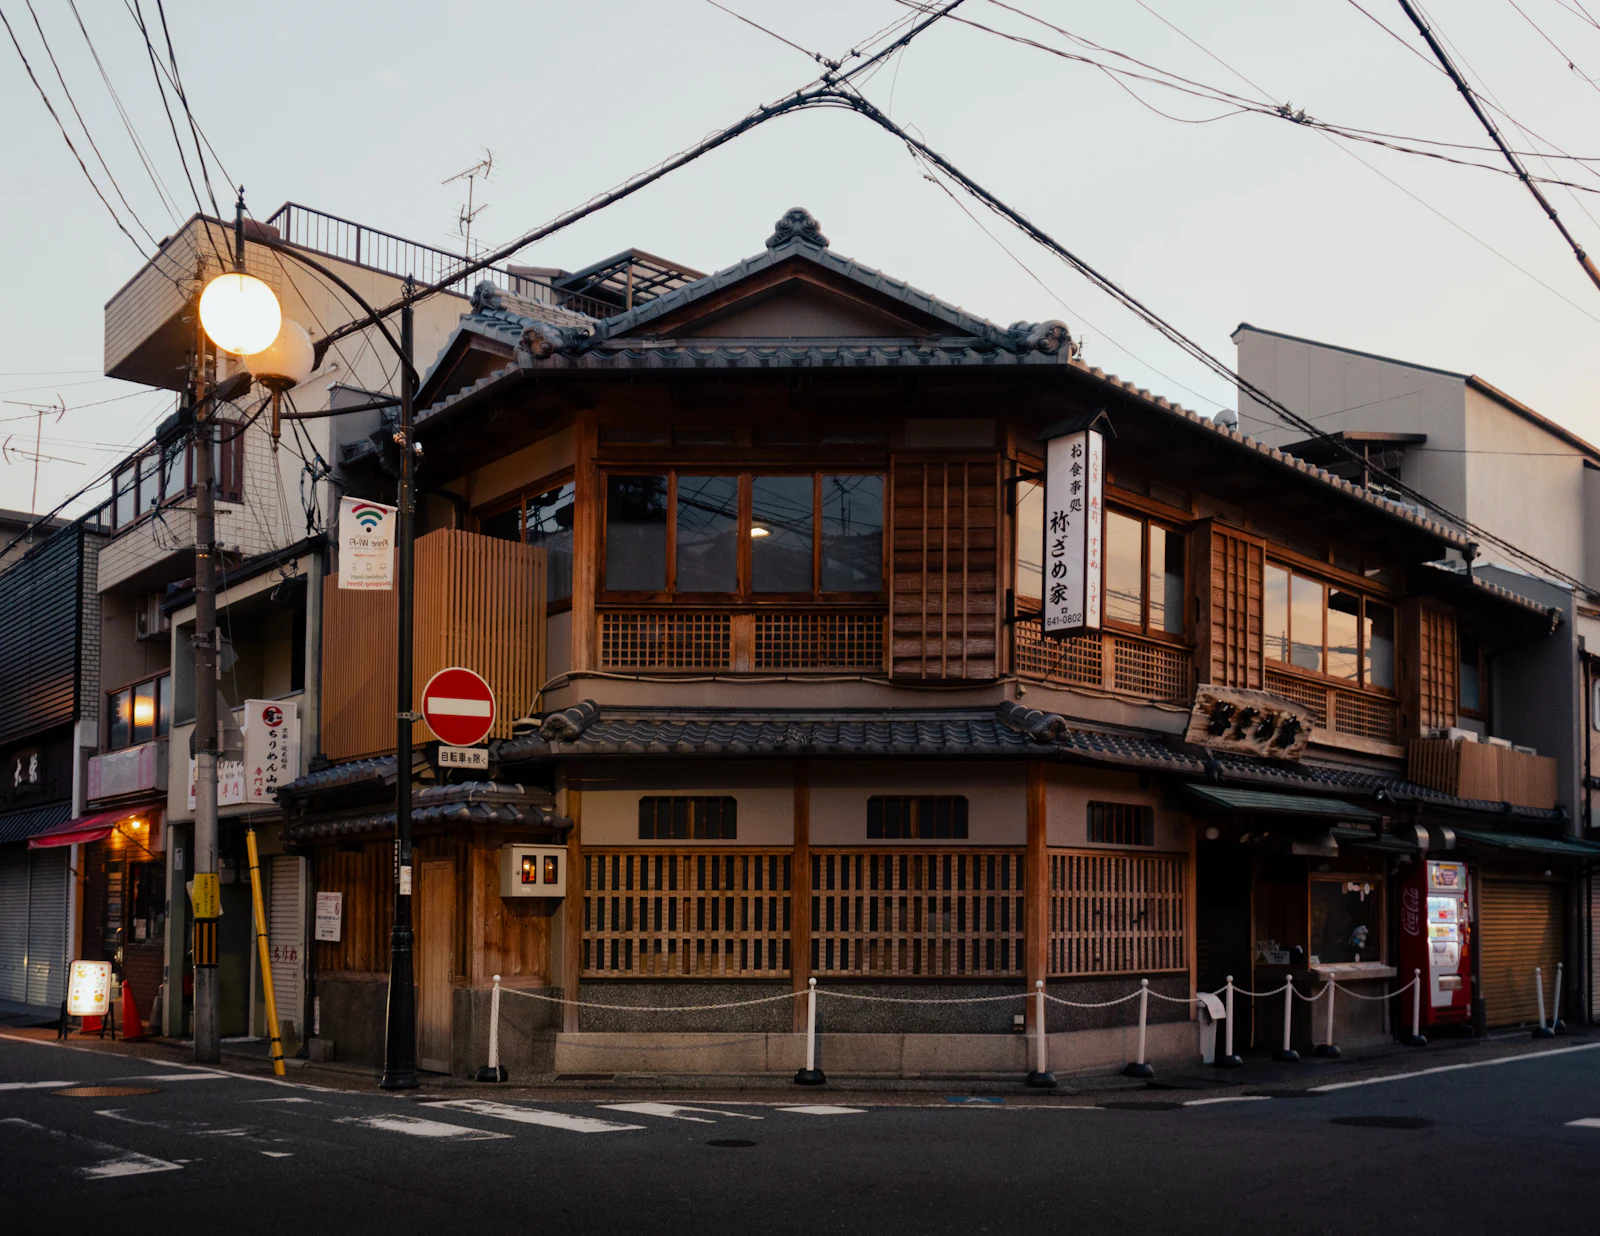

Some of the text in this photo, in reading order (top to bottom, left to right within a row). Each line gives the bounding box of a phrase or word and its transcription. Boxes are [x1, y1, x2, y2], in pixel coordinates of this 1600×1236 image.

[1069, 443, 1083, 513] お食事処
[1091, 496, 1099, 524] 寿司
[1046, 612, 1083, 627] 641-0802
[265, 729, 278, 795] ちりめん山椒
[441, 751, 486, 764] 自転車を除く
